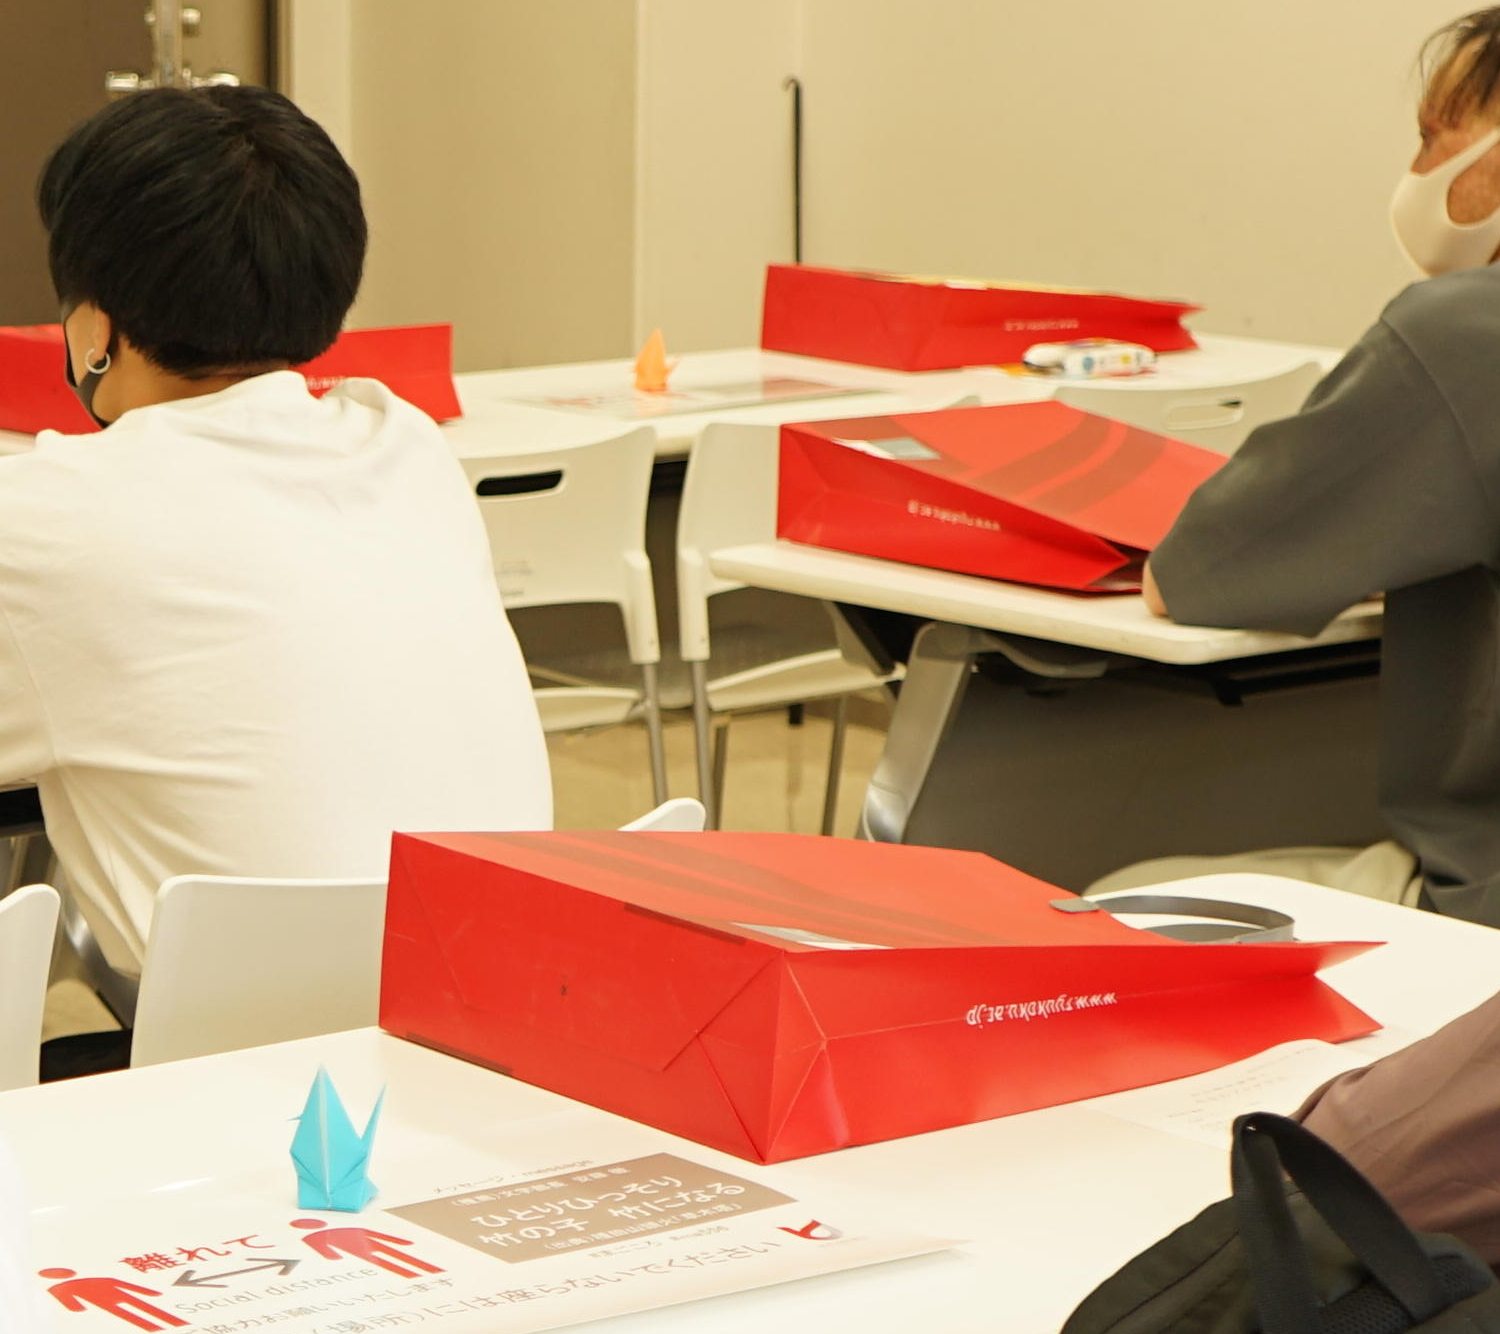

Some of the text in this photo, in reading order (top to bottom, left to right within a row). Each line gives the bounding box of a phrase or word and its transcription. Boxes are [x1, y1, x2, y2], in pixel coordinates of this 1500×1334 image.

[966, 992, 1117, 1029] www.ryukoku.ac.jp
[471, 1174, 682, 1229] ひとりひっそり
[479, 1217, 589, 1248] 竹の子
[608, 1182, 745, 1220] 竹になる
[118, 1234, 277, 1273] 離れて
[175, 1266, 378, 1315] Social distance
